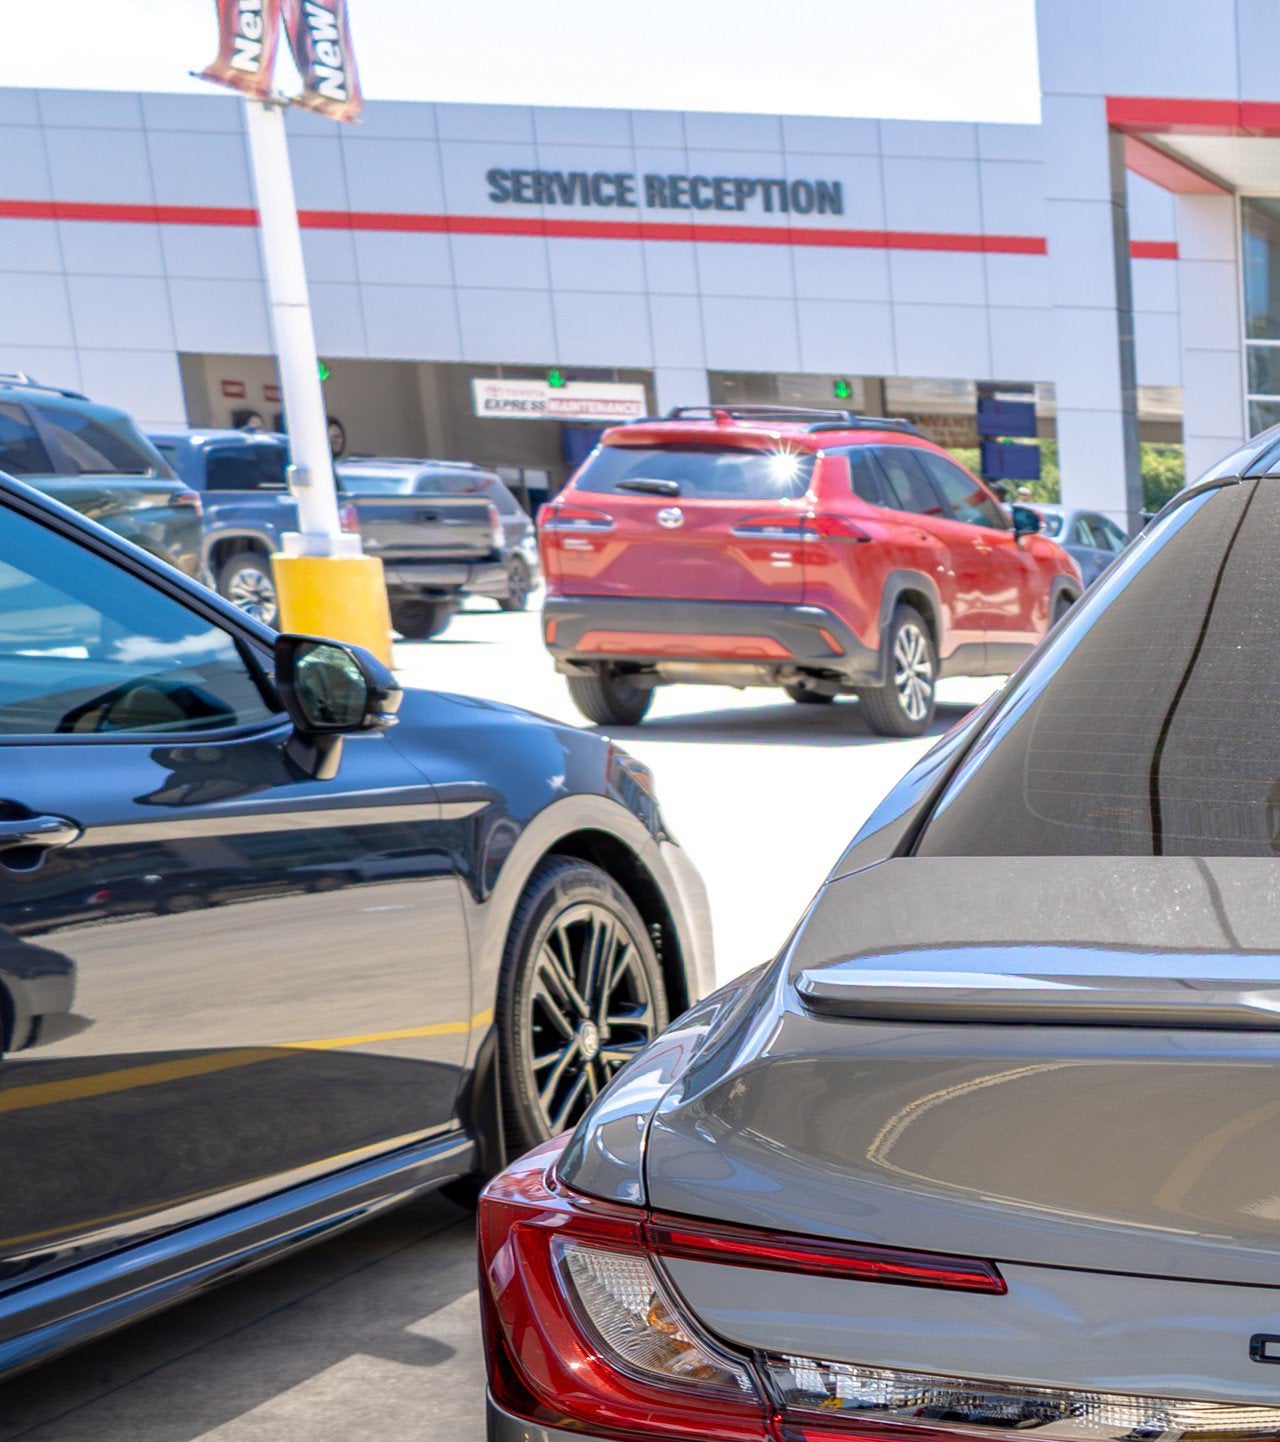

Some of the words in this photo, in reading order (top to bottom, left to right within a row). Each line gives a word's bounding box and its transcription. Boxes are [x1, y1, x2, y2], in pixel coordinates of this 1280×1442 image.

[486, 168, 637, 208] SERVICE
[643, 173, 844, 216] RECEPTION
[484, 398, 547, 412] EXPRESS
